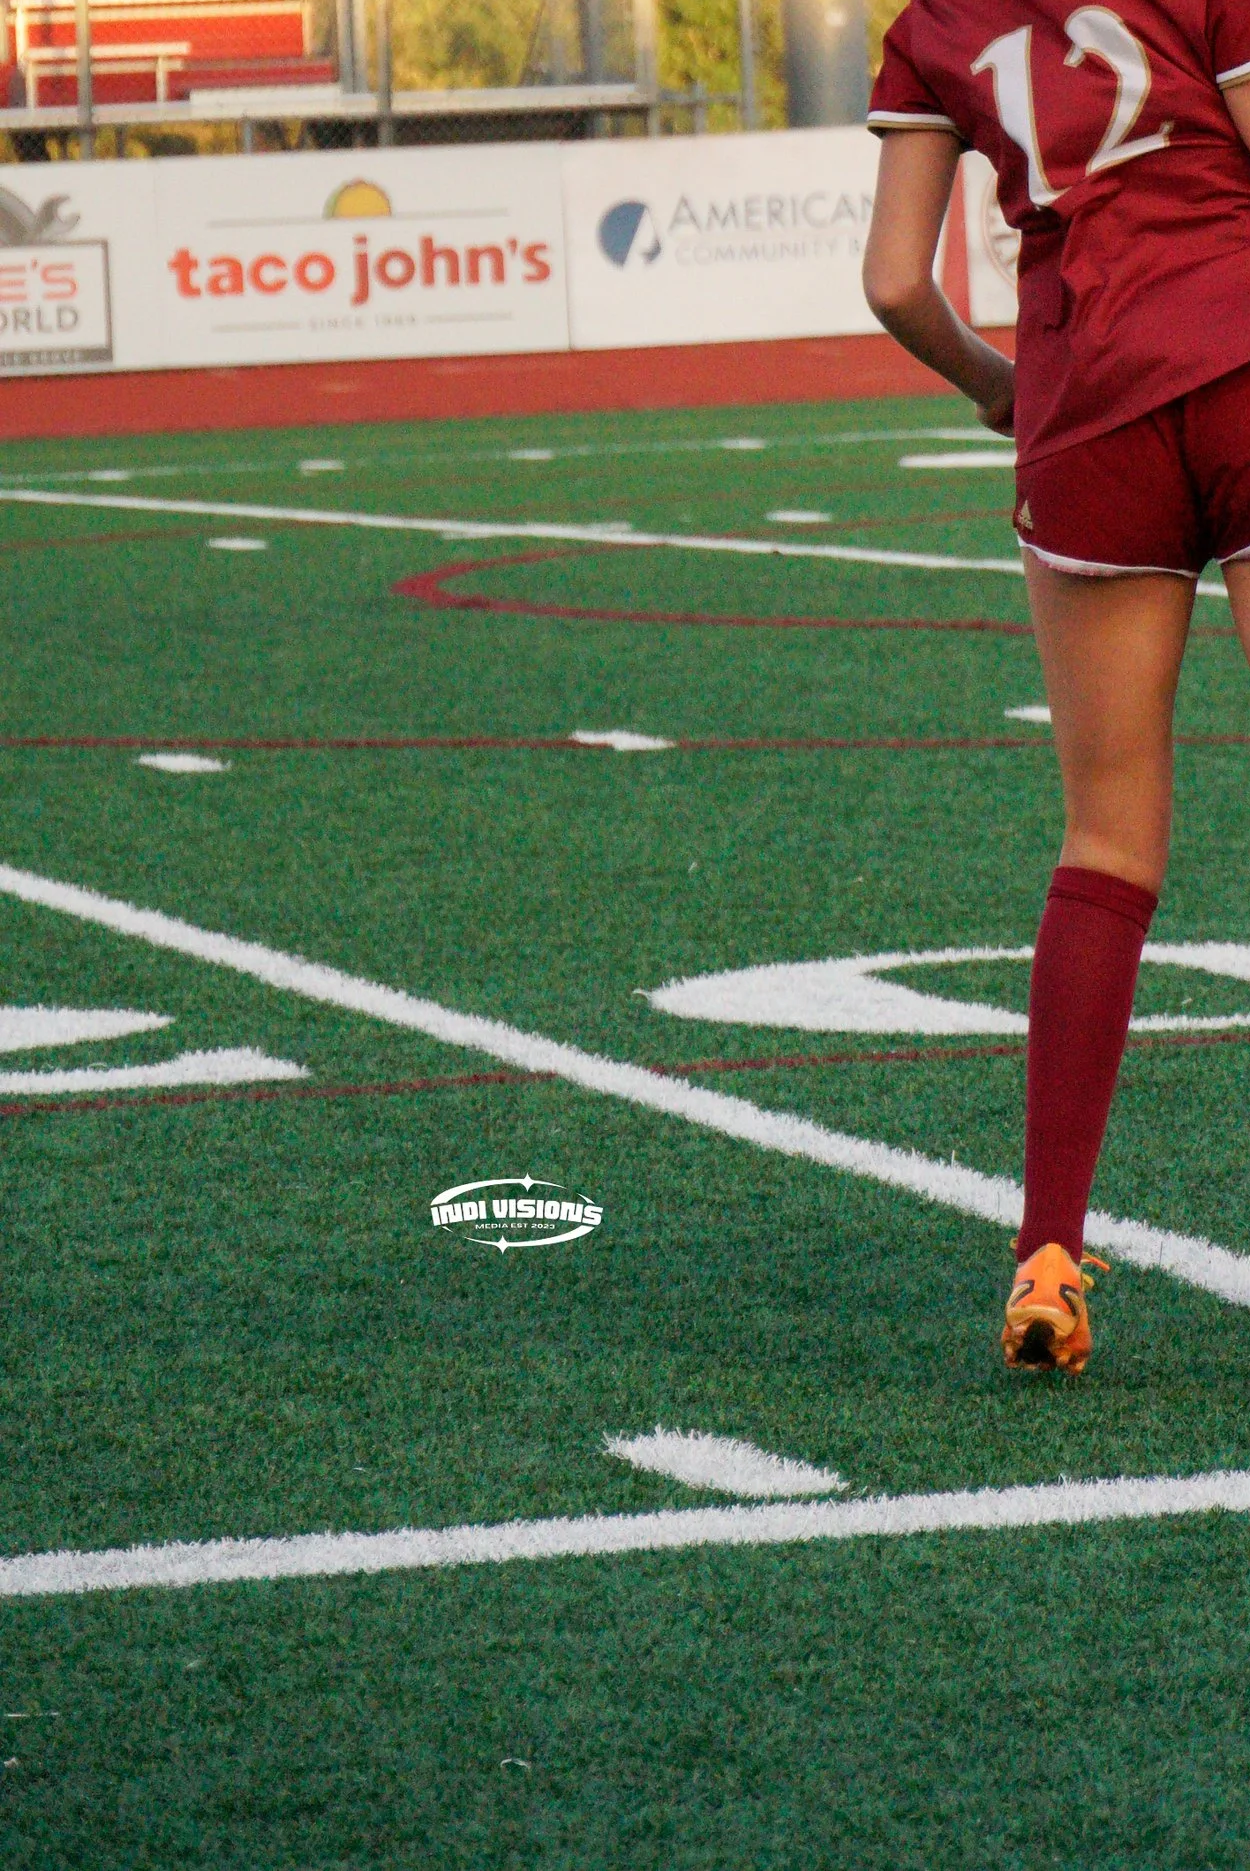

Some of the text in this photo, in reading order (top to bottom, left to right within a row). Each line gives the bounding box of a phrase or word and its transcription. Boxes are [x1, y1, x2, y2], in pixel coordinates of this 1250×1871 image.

[970, 5, 1175, 210] 12
[168, 235, 552, 307] taco john's
